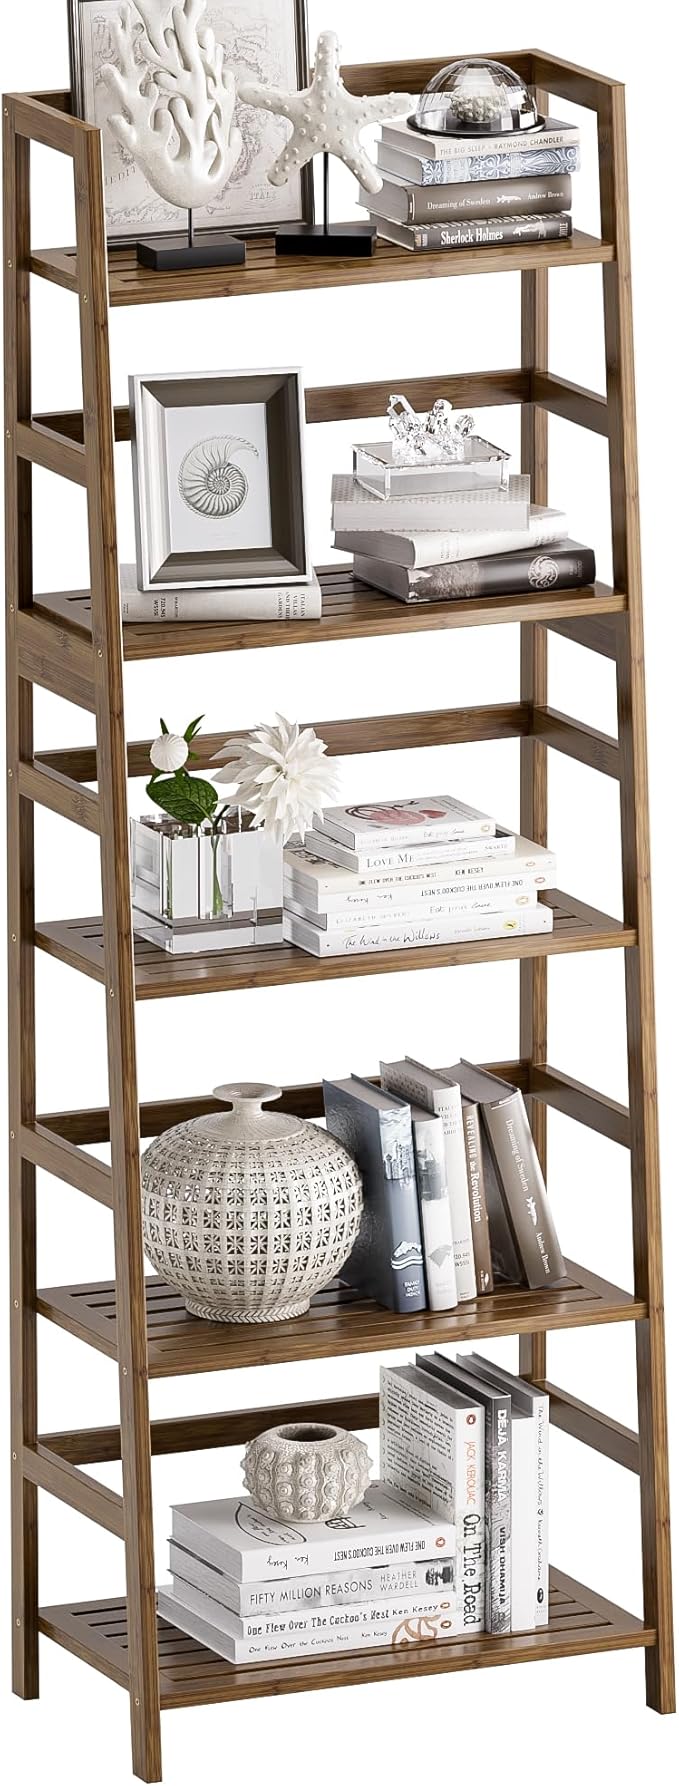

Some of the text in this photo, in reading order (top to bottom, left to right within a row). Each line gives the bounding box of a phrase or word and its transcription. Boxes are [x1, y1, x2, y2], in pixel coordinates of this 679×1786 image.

[440, 136, 564, 156] THE BIG SLEEP RAYMOND CHANDLER
[427, 190, 565, 210] Dreaming of Sweden Andrew Brown
[440, 229, 474, 246] Sherlock
[475, 227, 504, 242] Holmes
[421, 888, 436, 896] NEST
[466, 884, 476, 892] THE
[479, 882, 494, 890] OVER
[494, 880, 510, 888] FLEW
[343, 936, 356, 949] The
[359, 934, 380, 946] Wind
[403, 928, 440, 944] Willows
[466, 1115, 478, 1159] REVEALING
[471, 1172, 482, 1222] Revolution
[506, 1119, 550, 1274] Dreaming of Sweden Andrew Brown
[464, 1441, 476, 1504] JACK KEROUAC
[498, 1450, 508, 1502] KARMA
[334, 1540, 426, 1561] ONE FLEW OVER THE CUCKOO'S NEST
[266, 1554, 309, 1570] Ken Kesey
[463, 1513, 482, 1626] On The Road
[379, 1580, 418, 1592] WARDELL
[380, 1570, 418, 1582] HEATHER
[250, 1579, 374, 1606] FIFTY MILLION REASONS
[247, 1603, 438, 1636] One Flew Over The Cuckoo's Nest Ken Kesey
[249, 1646, 262, 1654] One
[280, 1642, 296, 1650] Over
[374, 1630, 388, 1638] Kesey
